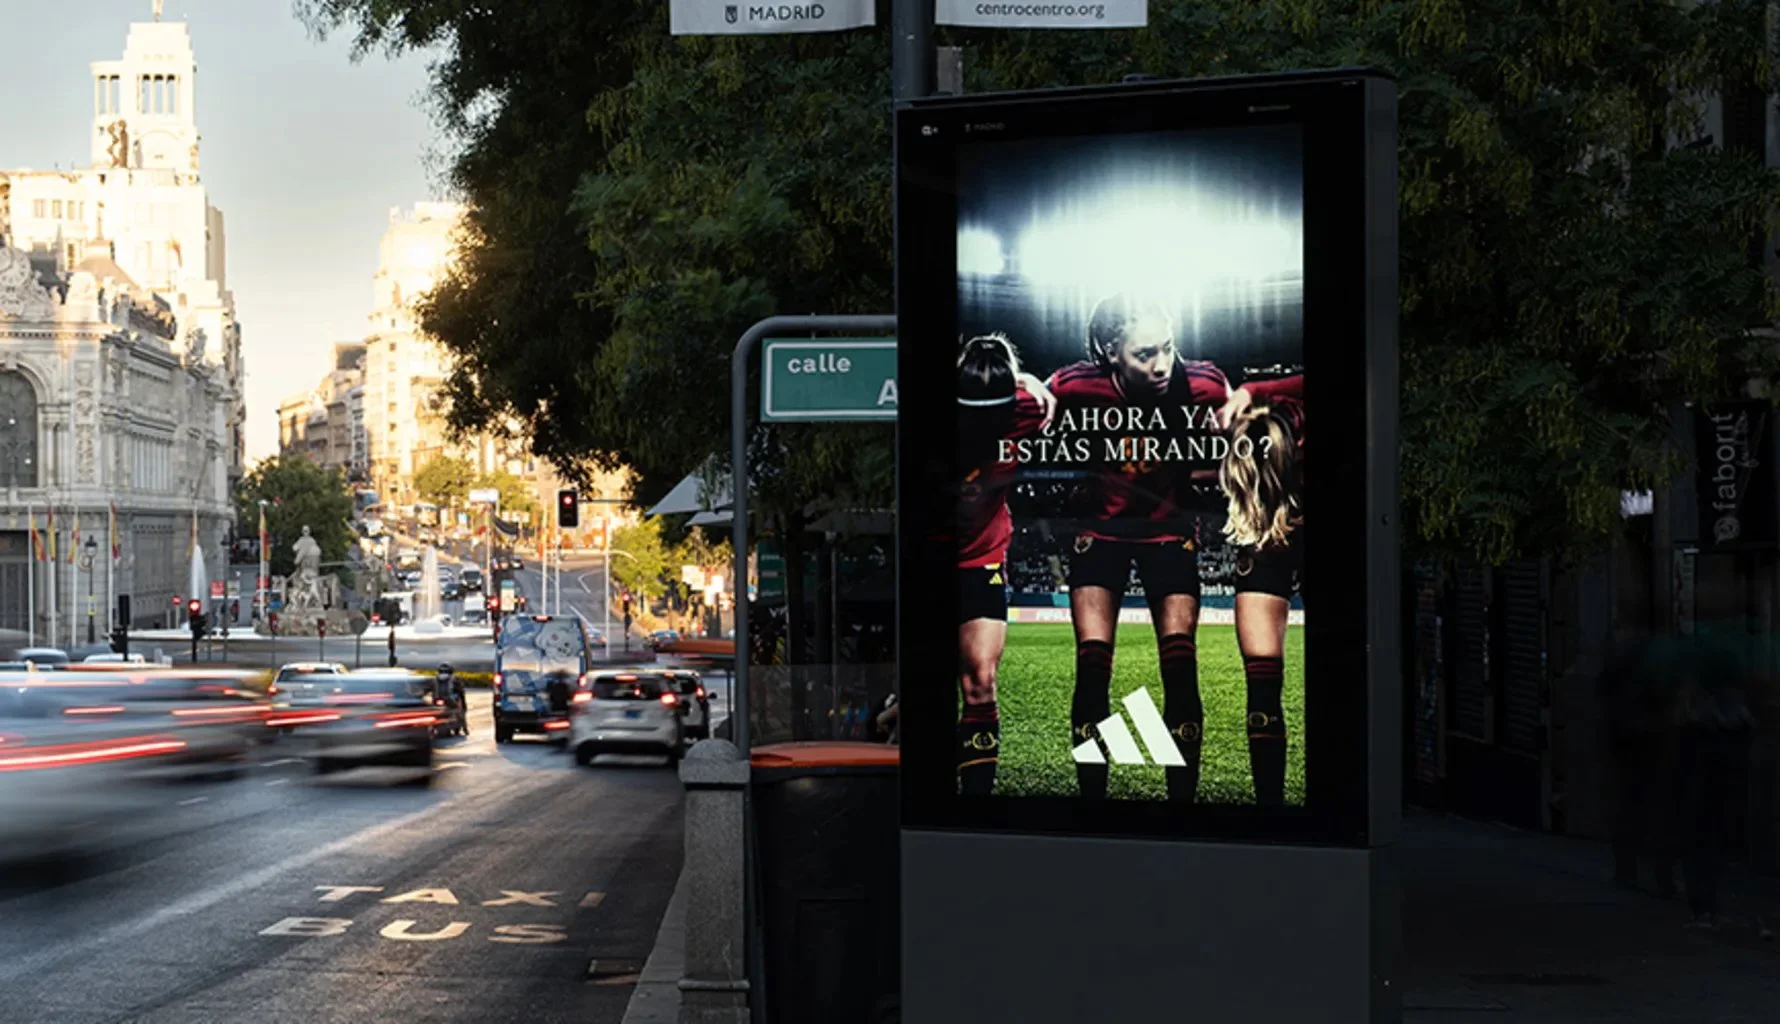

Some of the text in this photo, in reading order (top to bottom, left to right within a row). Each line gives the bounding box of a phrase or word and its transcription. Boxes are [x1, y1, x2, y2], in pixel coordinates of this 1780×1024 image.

[749, 4, 825, 21] MADRID
[975, 3, 1105, 19] centrocentro.org
[787, 353, 851, 373] calle
[1042, 405, 1221, 436] ¿AHORA YA
[998, 431, 1273, 463] ESTÁS MIRANDO?
[1711, 411, 1737, 511] faborit
[313, 885, 607, 908] TAXI
[257, 916, 569, 944] BUS
